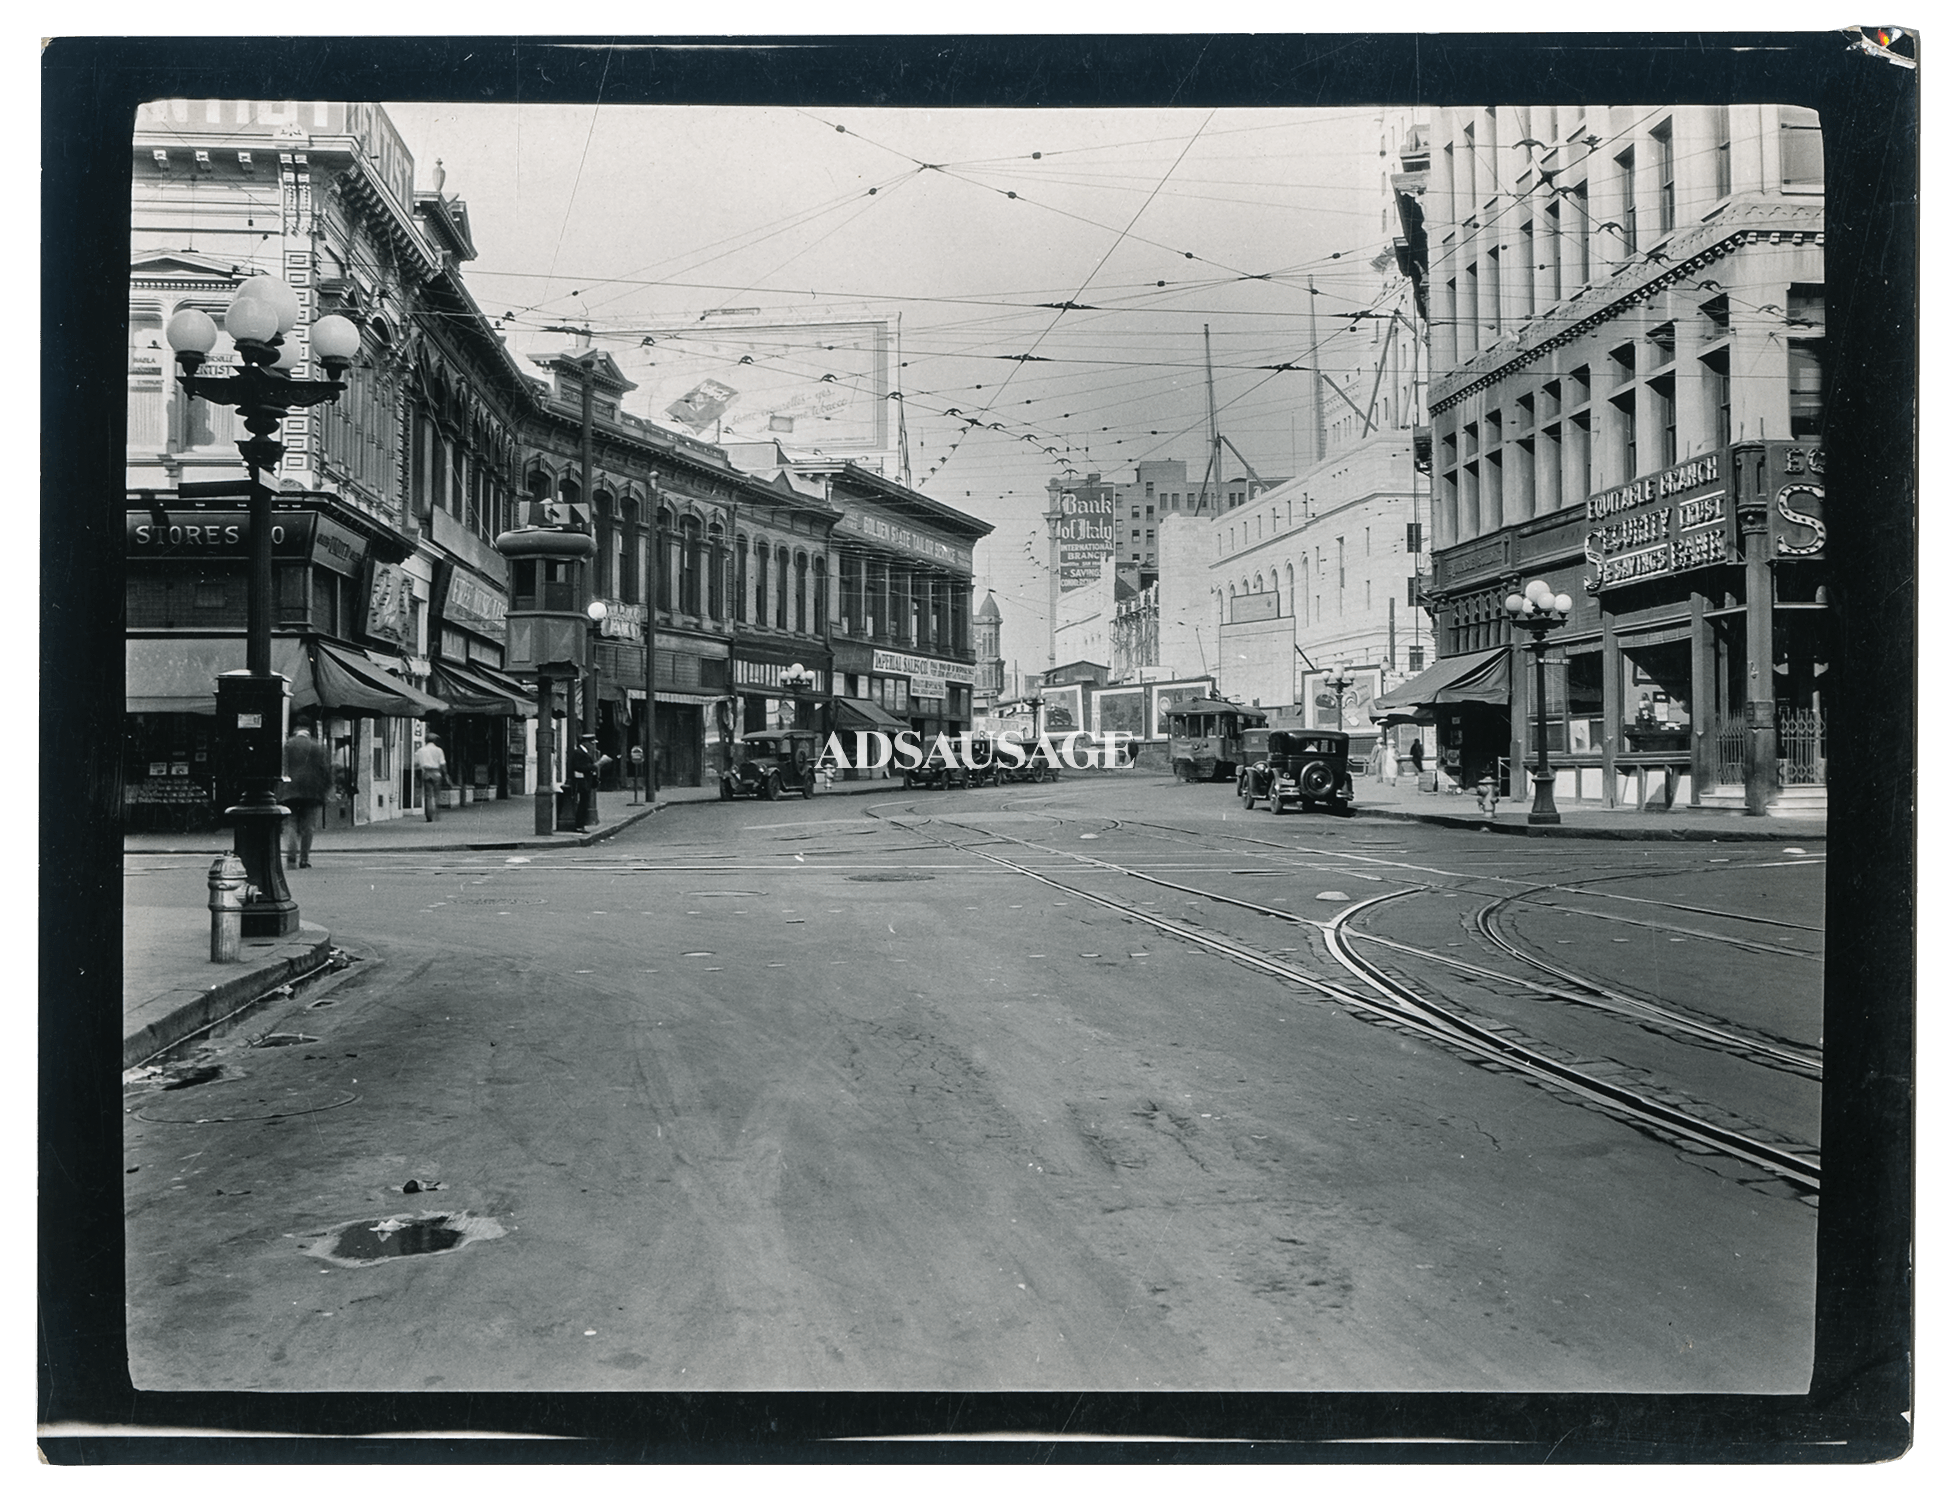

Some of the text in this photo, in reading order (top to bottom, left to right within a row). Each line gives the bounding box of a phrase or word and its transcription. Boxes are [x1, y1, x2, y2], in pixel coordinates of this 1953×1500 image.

[1587, 456, 1719, 521] EQUITABLE BRANCH
[1062, 493, 1112, 515] Bank
[135, 525, 239, 545] STORES
[891, 526, 911, 548] STATE
[1062, 518, 1113, 544] of Italy
[1061, 543, 1114, 552] INTERNATIONAL
[1584, 496, 1724, 590] SECURITY TRUST
[1614, 549, 1667, 578] SAVINGS
[1670, 529, 1726, 571] BANK
[1067, 551, 1107, 560] BRANCH
[875, 652, 902, 672] IMPERIAL
[903, 657, 920, 674] SALES
